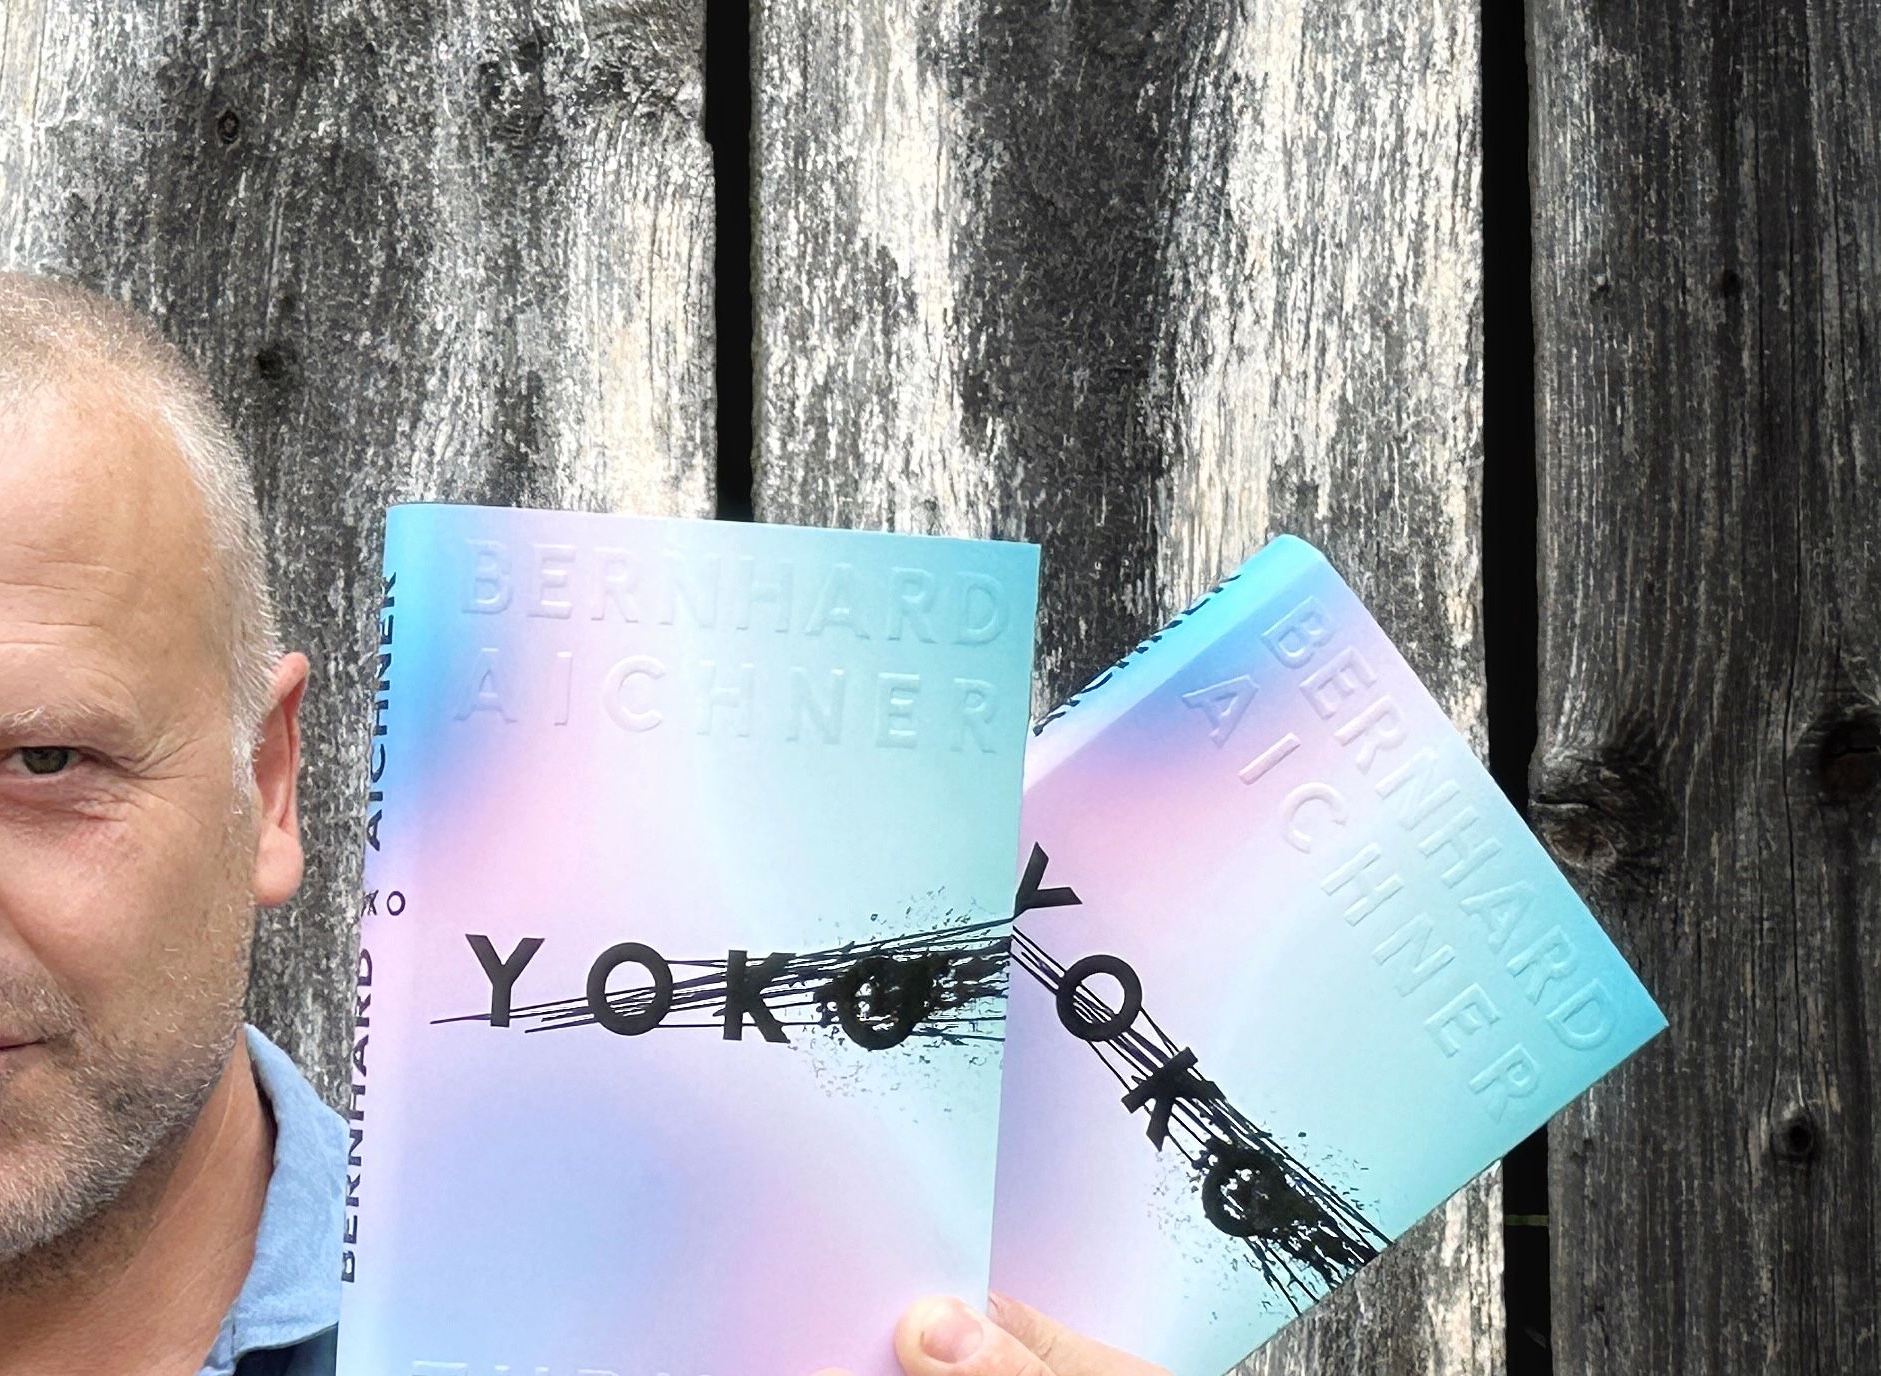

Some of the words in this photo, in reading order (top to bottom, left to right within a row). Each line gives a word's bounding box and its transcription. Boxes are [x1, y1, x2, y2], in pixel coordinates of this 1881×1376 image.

[460, 538, 1011, 647] BERNHARD
[454, 647, 1004, 755] AICHNER
[1261, 594, 1617, 1053] BERNHARD
[1182, 672, 1543, 1123] AICHNER
[464, 933, 927, 1051] YOKO
